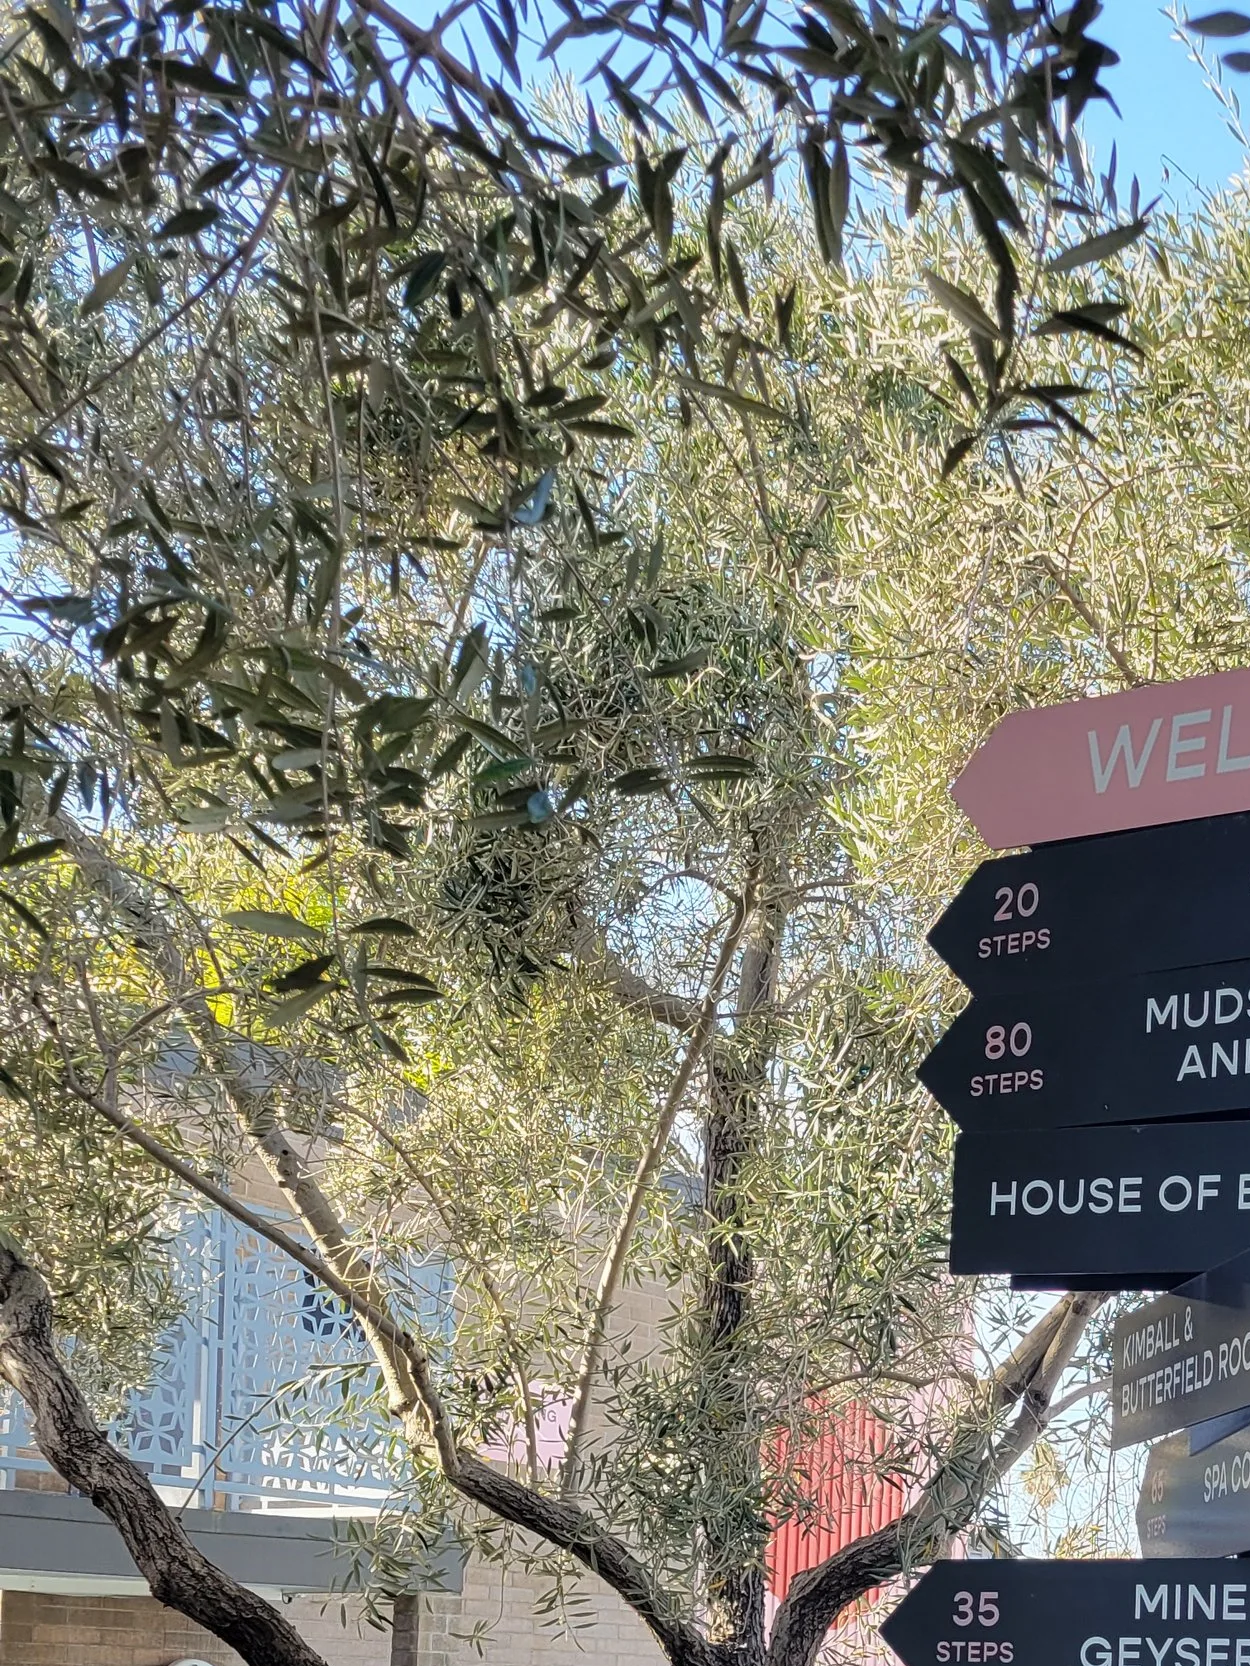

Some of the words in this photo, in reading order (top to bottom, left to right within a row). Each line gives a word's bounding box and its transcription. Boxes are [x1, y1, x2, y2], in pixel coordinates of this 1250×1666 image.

[993, 883, 1040, 922] 20
[978, 928, 1051, 959] STEPS
[984, 1020, 1032, 1061] 80
[970, 1069, 1044, 1098] STEPS
[989, 1175, 1142, 1217] HOUSE
[1158, 1175, 1219, 1211] OF
[1122, 1310, 1180, 1369] KIMBALL
[1184, 1306, 1193, 1342] &
[1121, 1350, 1214, 1418] BUTTERFIELD
[1203, 1460, 1228, 1503] SPA
[952, 1592, 1000, 1626] 35
[936, 1641, 1014, 1664] STEPS
